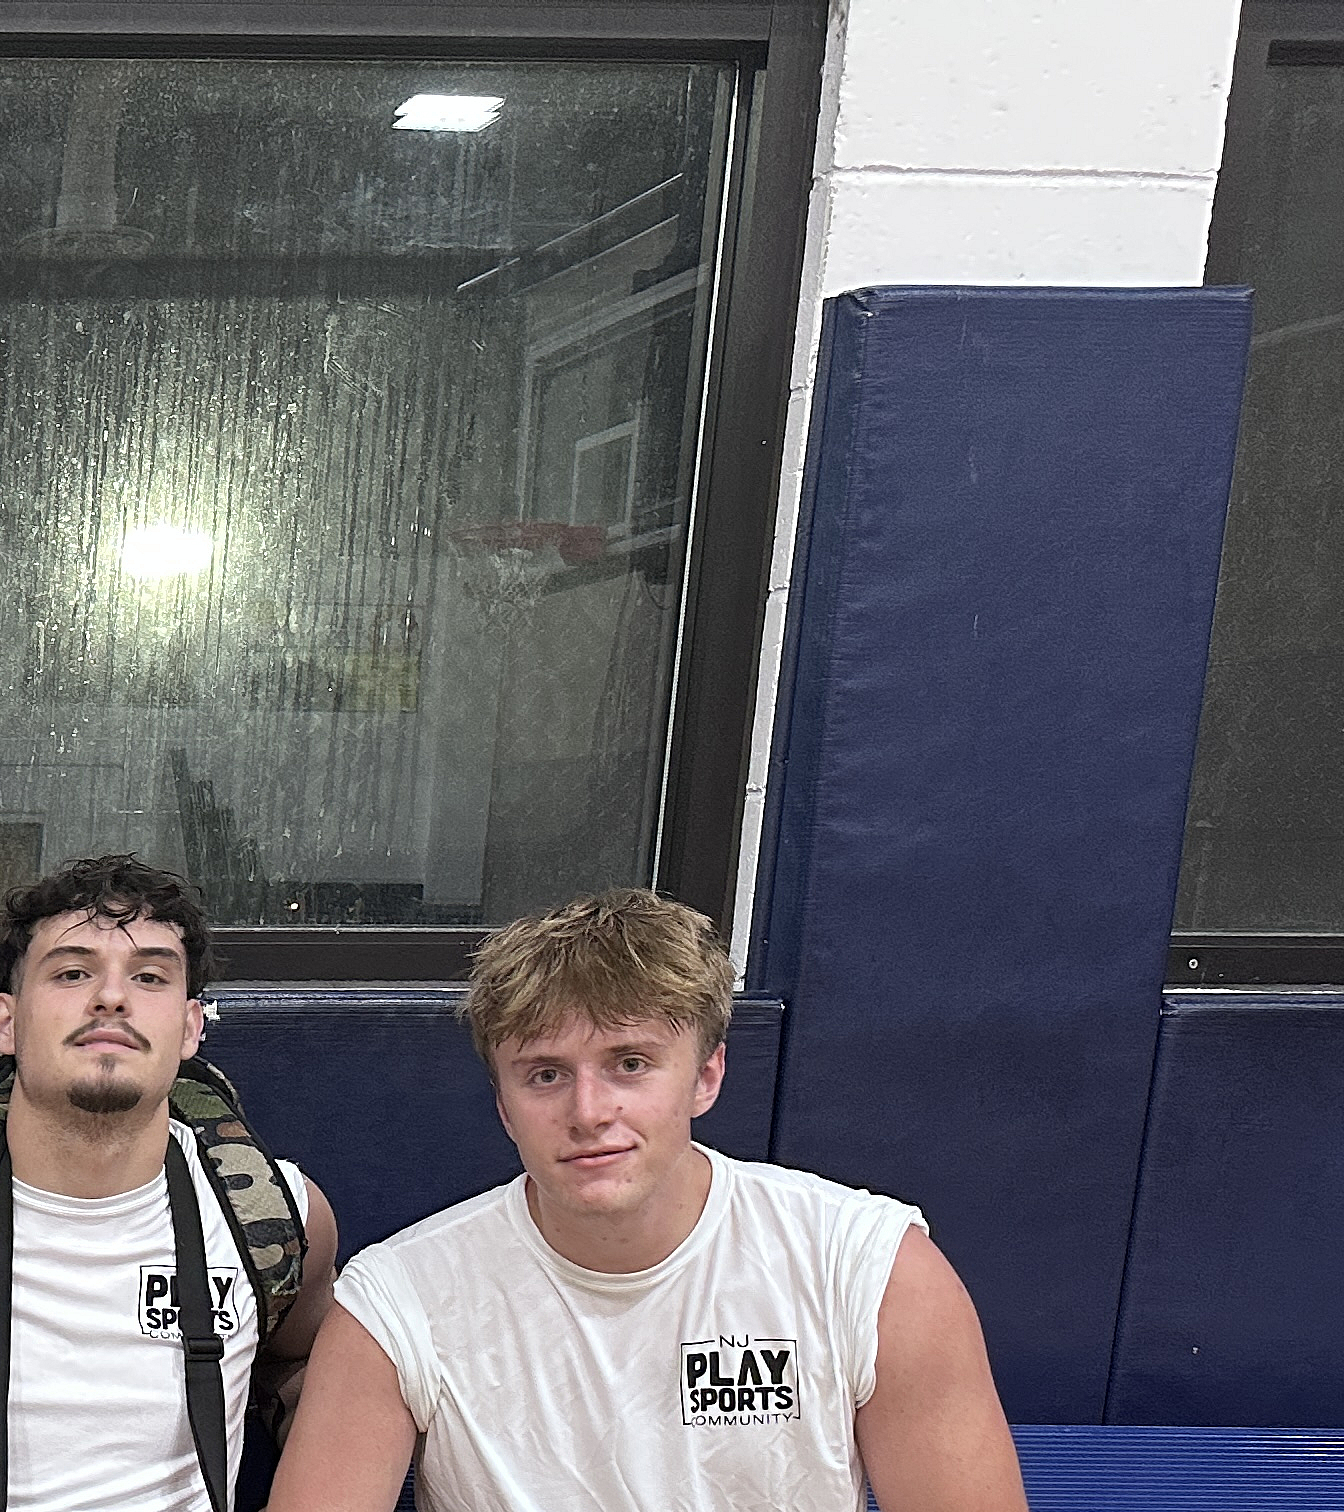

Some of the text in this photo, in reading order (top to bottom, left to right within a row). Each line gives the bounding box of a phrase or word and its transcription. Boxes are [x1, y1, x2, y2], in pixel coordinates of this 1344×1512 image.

[145, 1274, 233, 1309] PY
[145, 1307, 234, 1331] SPS
[719, 1334, 750, 1349] NJ
[686, 1349, 791, 1389] PLAY
[689, 1385, 794, 1413] SPORTS
[691, 1412, 794, 1428] COMMUNITY
